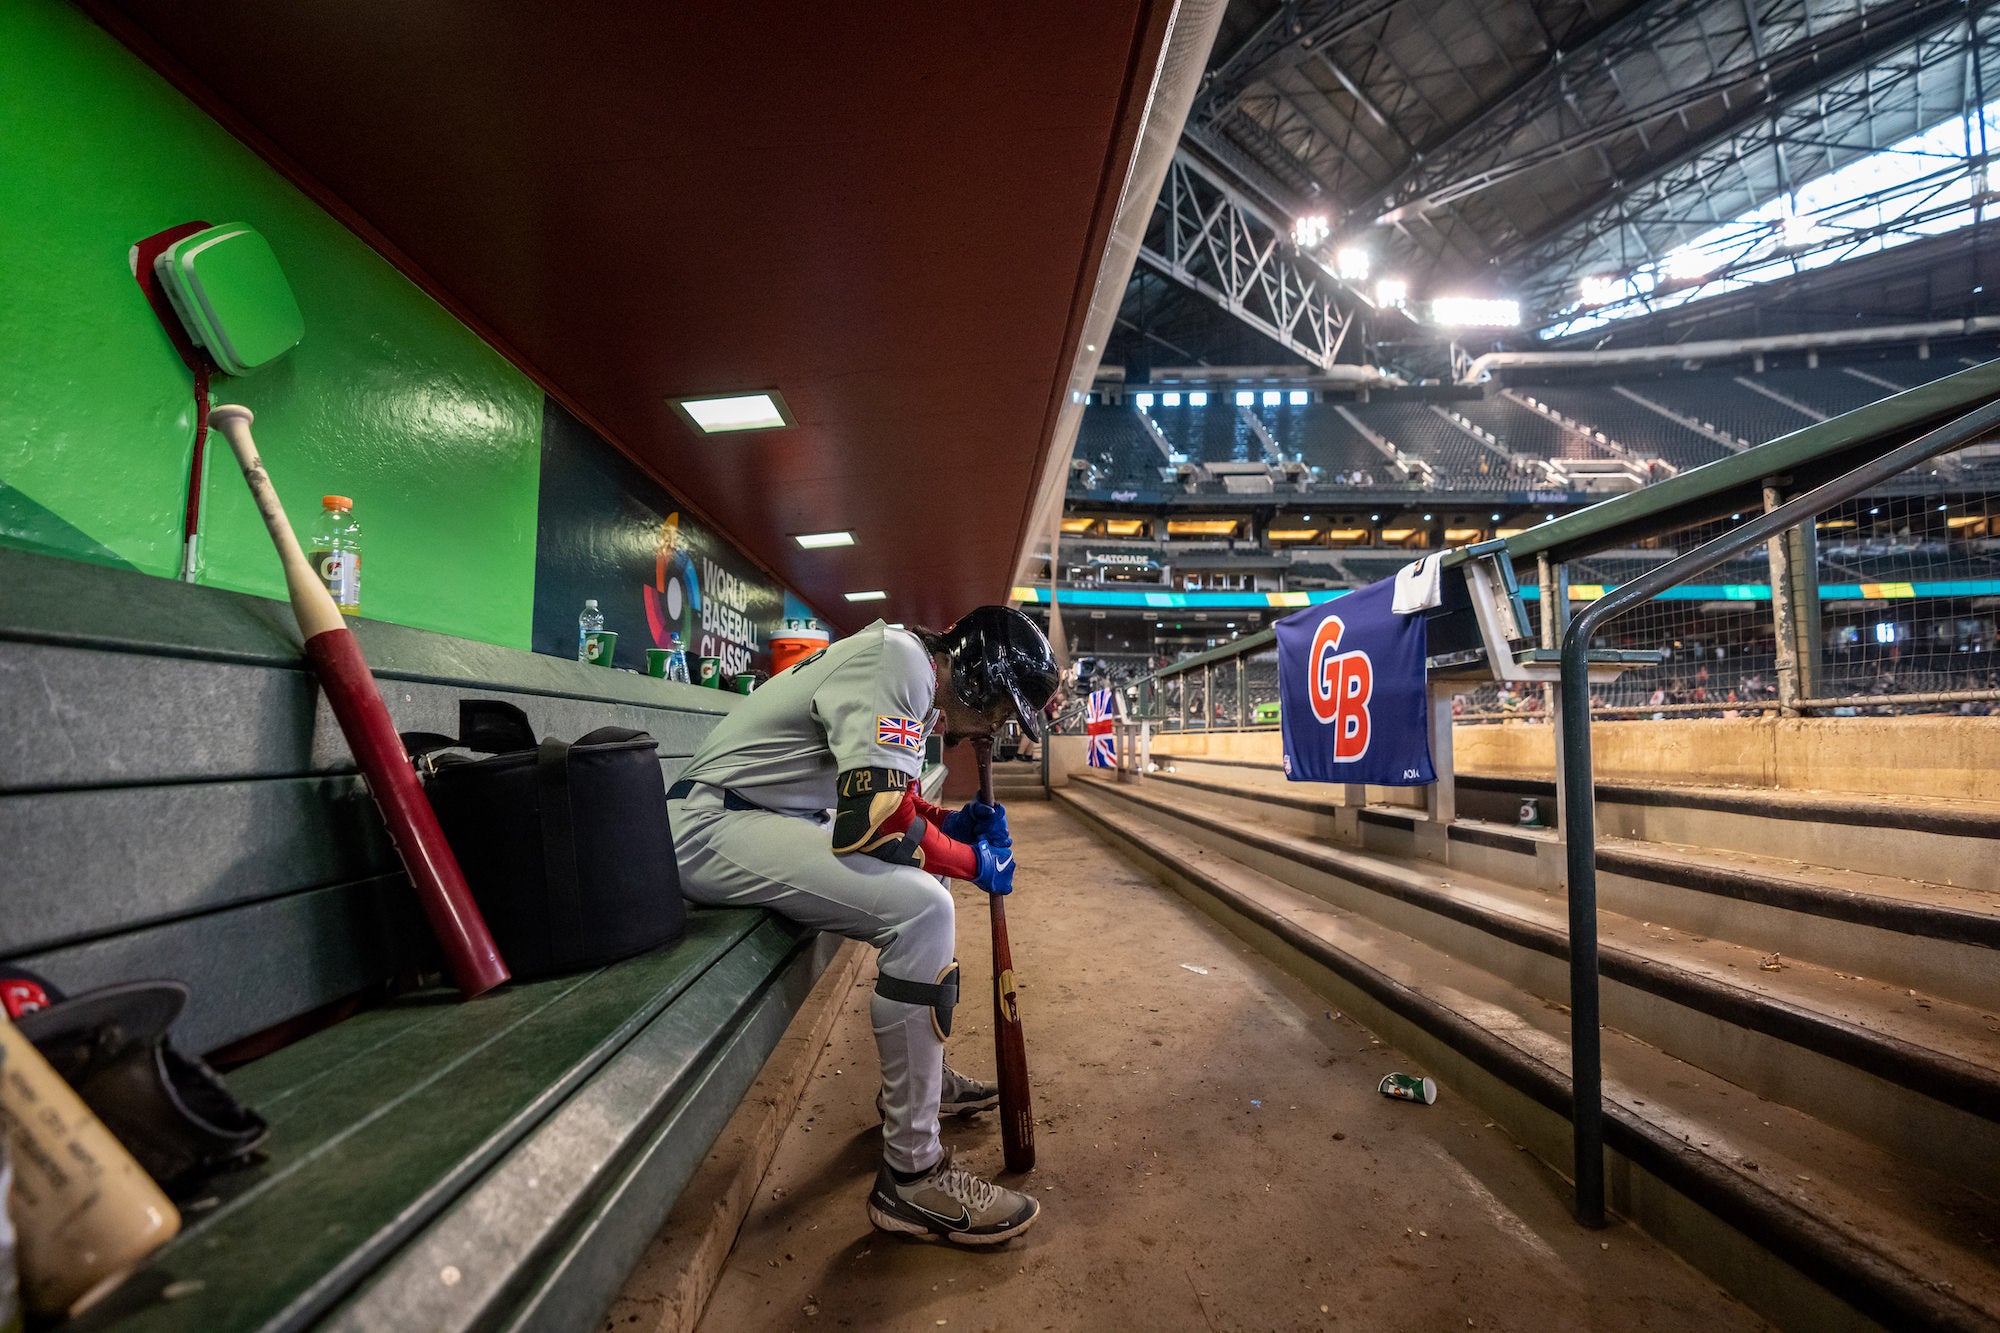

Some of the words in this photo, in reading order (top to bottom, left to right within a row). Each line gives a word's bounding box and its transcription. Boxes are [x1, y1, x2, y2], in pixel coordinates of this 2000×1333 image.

[321, 556, 343, 580] G
[1099, 555, 1148, 565] GATORADE
[703, 557, 747, 613] WORLD
[702, 596, 759, 652] BASEBALL
[585, 639, 600, 660] G
[701, 663, 715, 679] G
[1308, 615, 1373, 763] GB
[855, 770, 873, 792] 22
